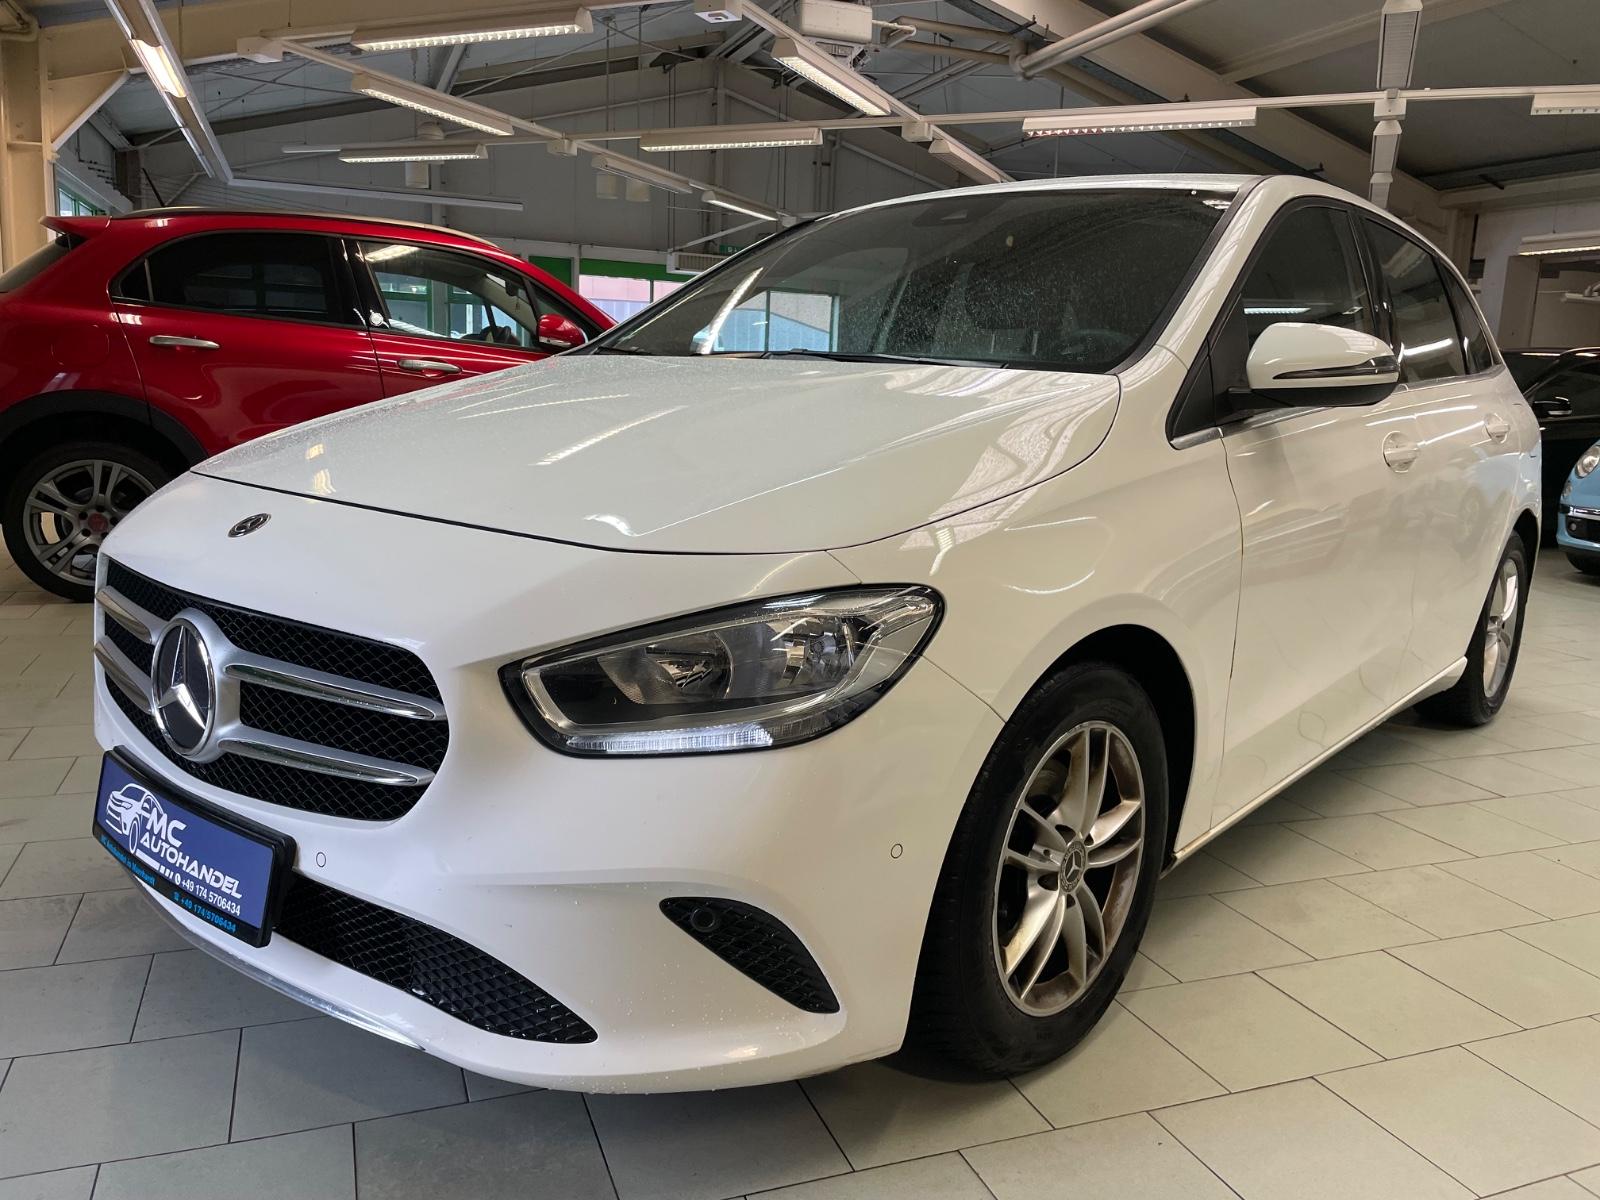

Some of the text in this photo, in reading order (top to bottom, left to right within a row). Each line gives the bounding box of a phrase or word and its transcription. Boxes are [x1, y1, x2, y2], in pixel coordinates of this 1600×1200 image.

[146, 807, 187, 847] MC
[140, 832, 242, 899] AUTOHANDEL
[182, 879, 241, 916] +49 174 5706434
